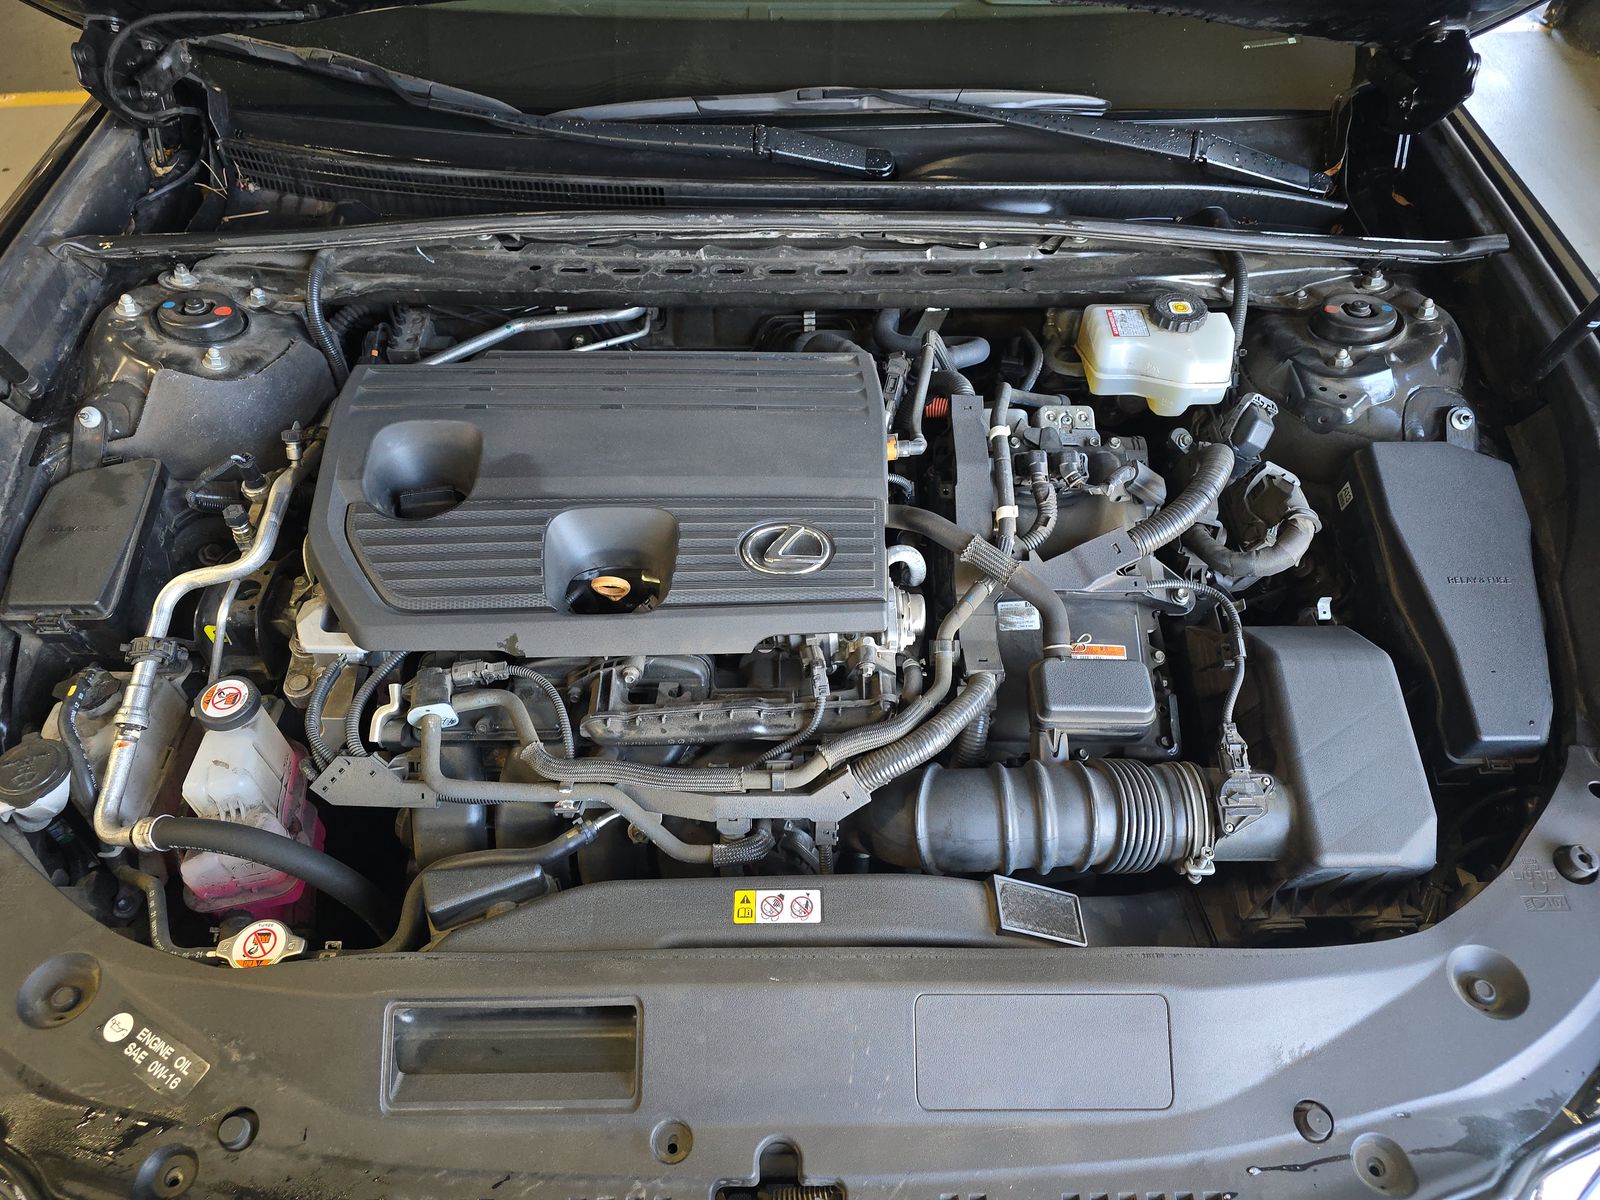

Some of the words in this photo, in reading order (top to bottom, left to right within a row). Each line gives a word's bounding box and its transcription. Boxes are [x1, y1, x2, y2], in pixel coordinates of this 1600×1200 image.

[1446, 576, 1477, 584] RELAY
[1487, 576, 1512, 585] FUSE
[123, 1042, 149, 1065] SAE
[146, 1060, 182, 1090] 0W-16
[135, 1027, 176, 1061] ENGINE
[173, 1055, 193, 1076] OIL
